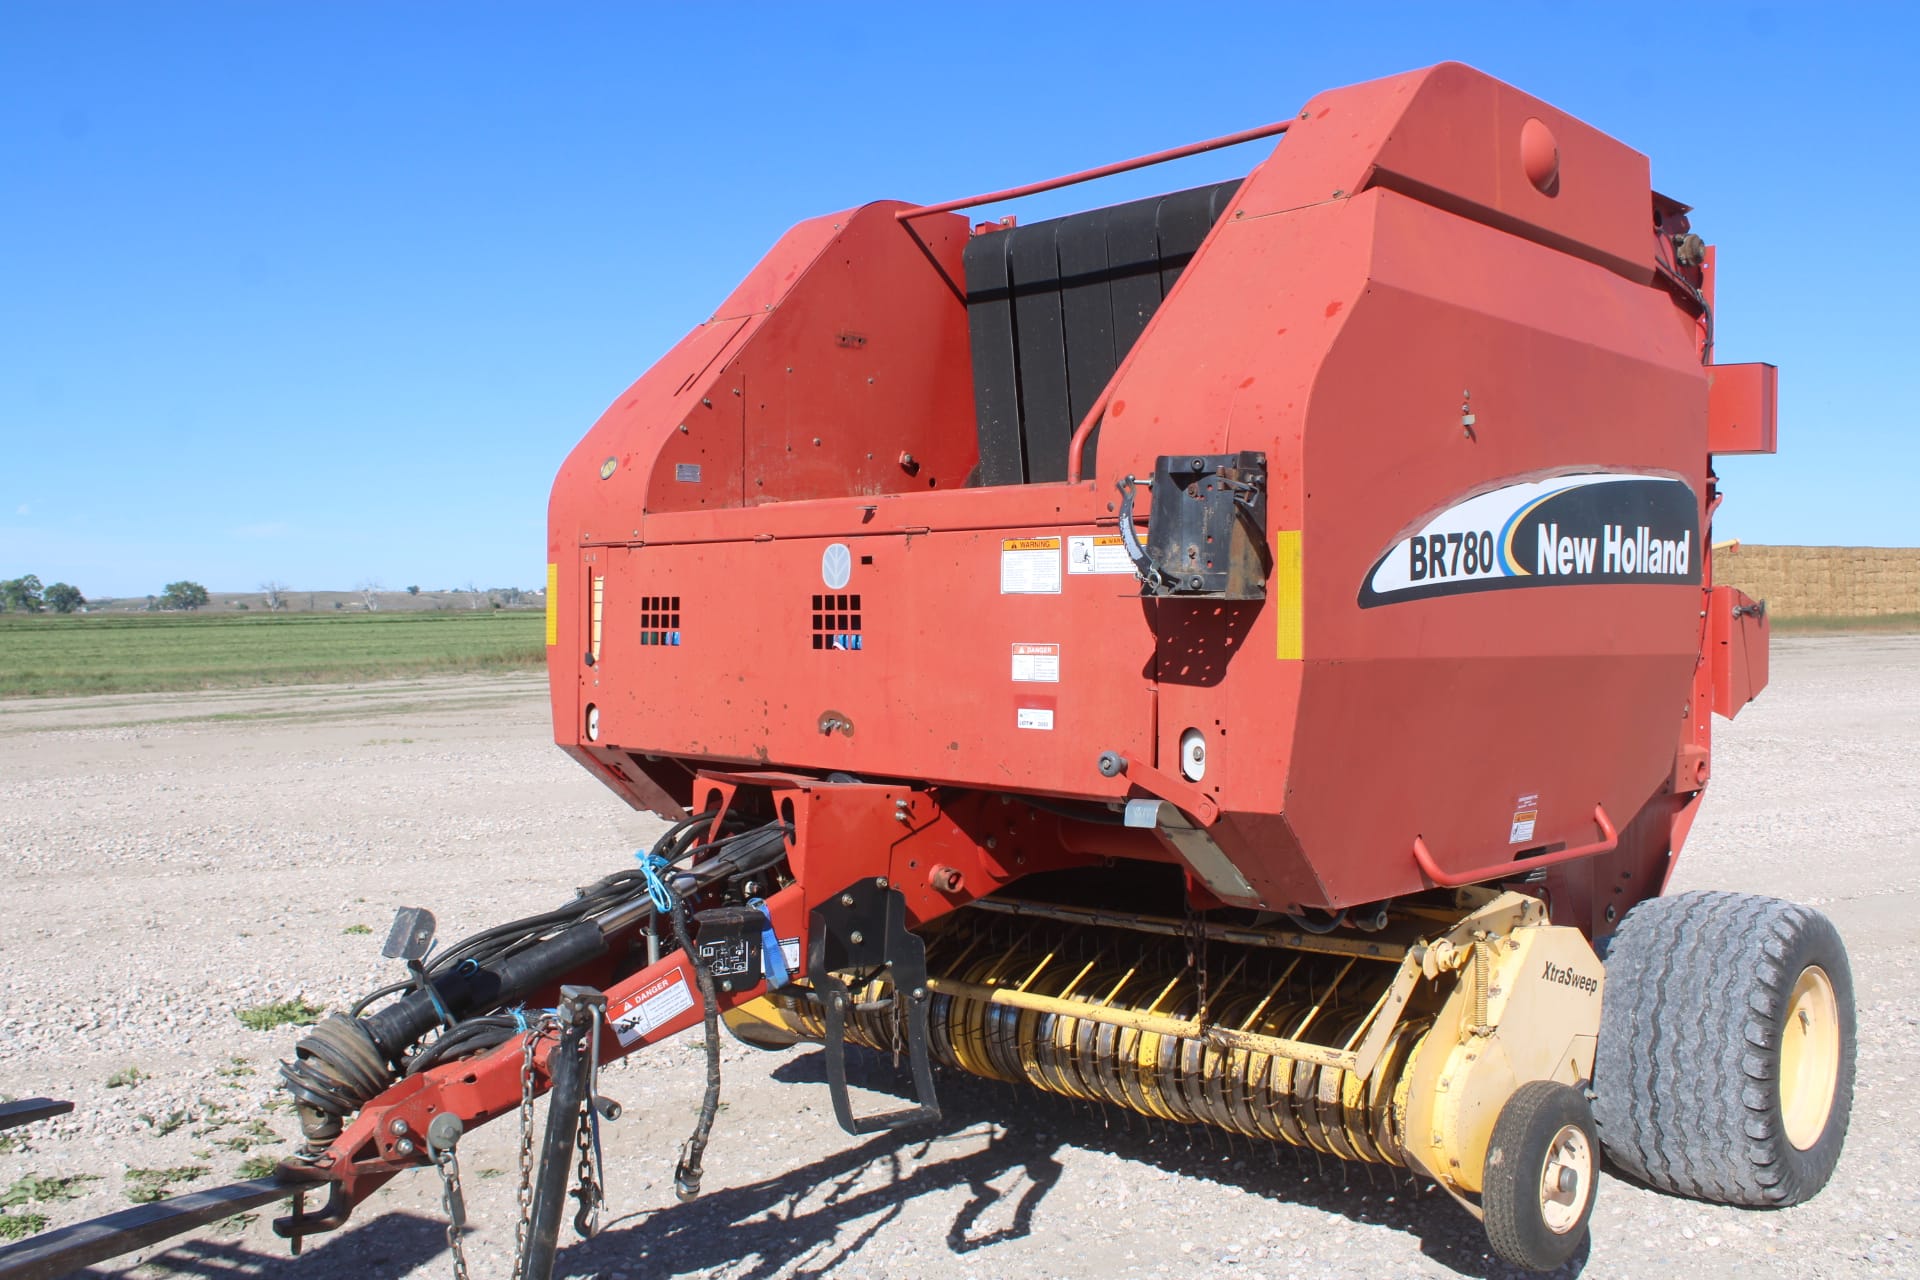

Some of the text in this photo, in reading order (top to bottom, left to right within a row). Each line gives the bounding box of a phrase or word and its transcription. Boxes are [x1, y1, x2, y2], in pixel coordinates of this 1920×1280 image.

[1020, 540, 1051, 549] WARNING
[1409, 530, 1494, 581] BR780
[1537, 523, 1690, 575] New Holland
[634, 979, 669, 1003] DANGER
[1541, 961, 1597, 996] XtraSweep
